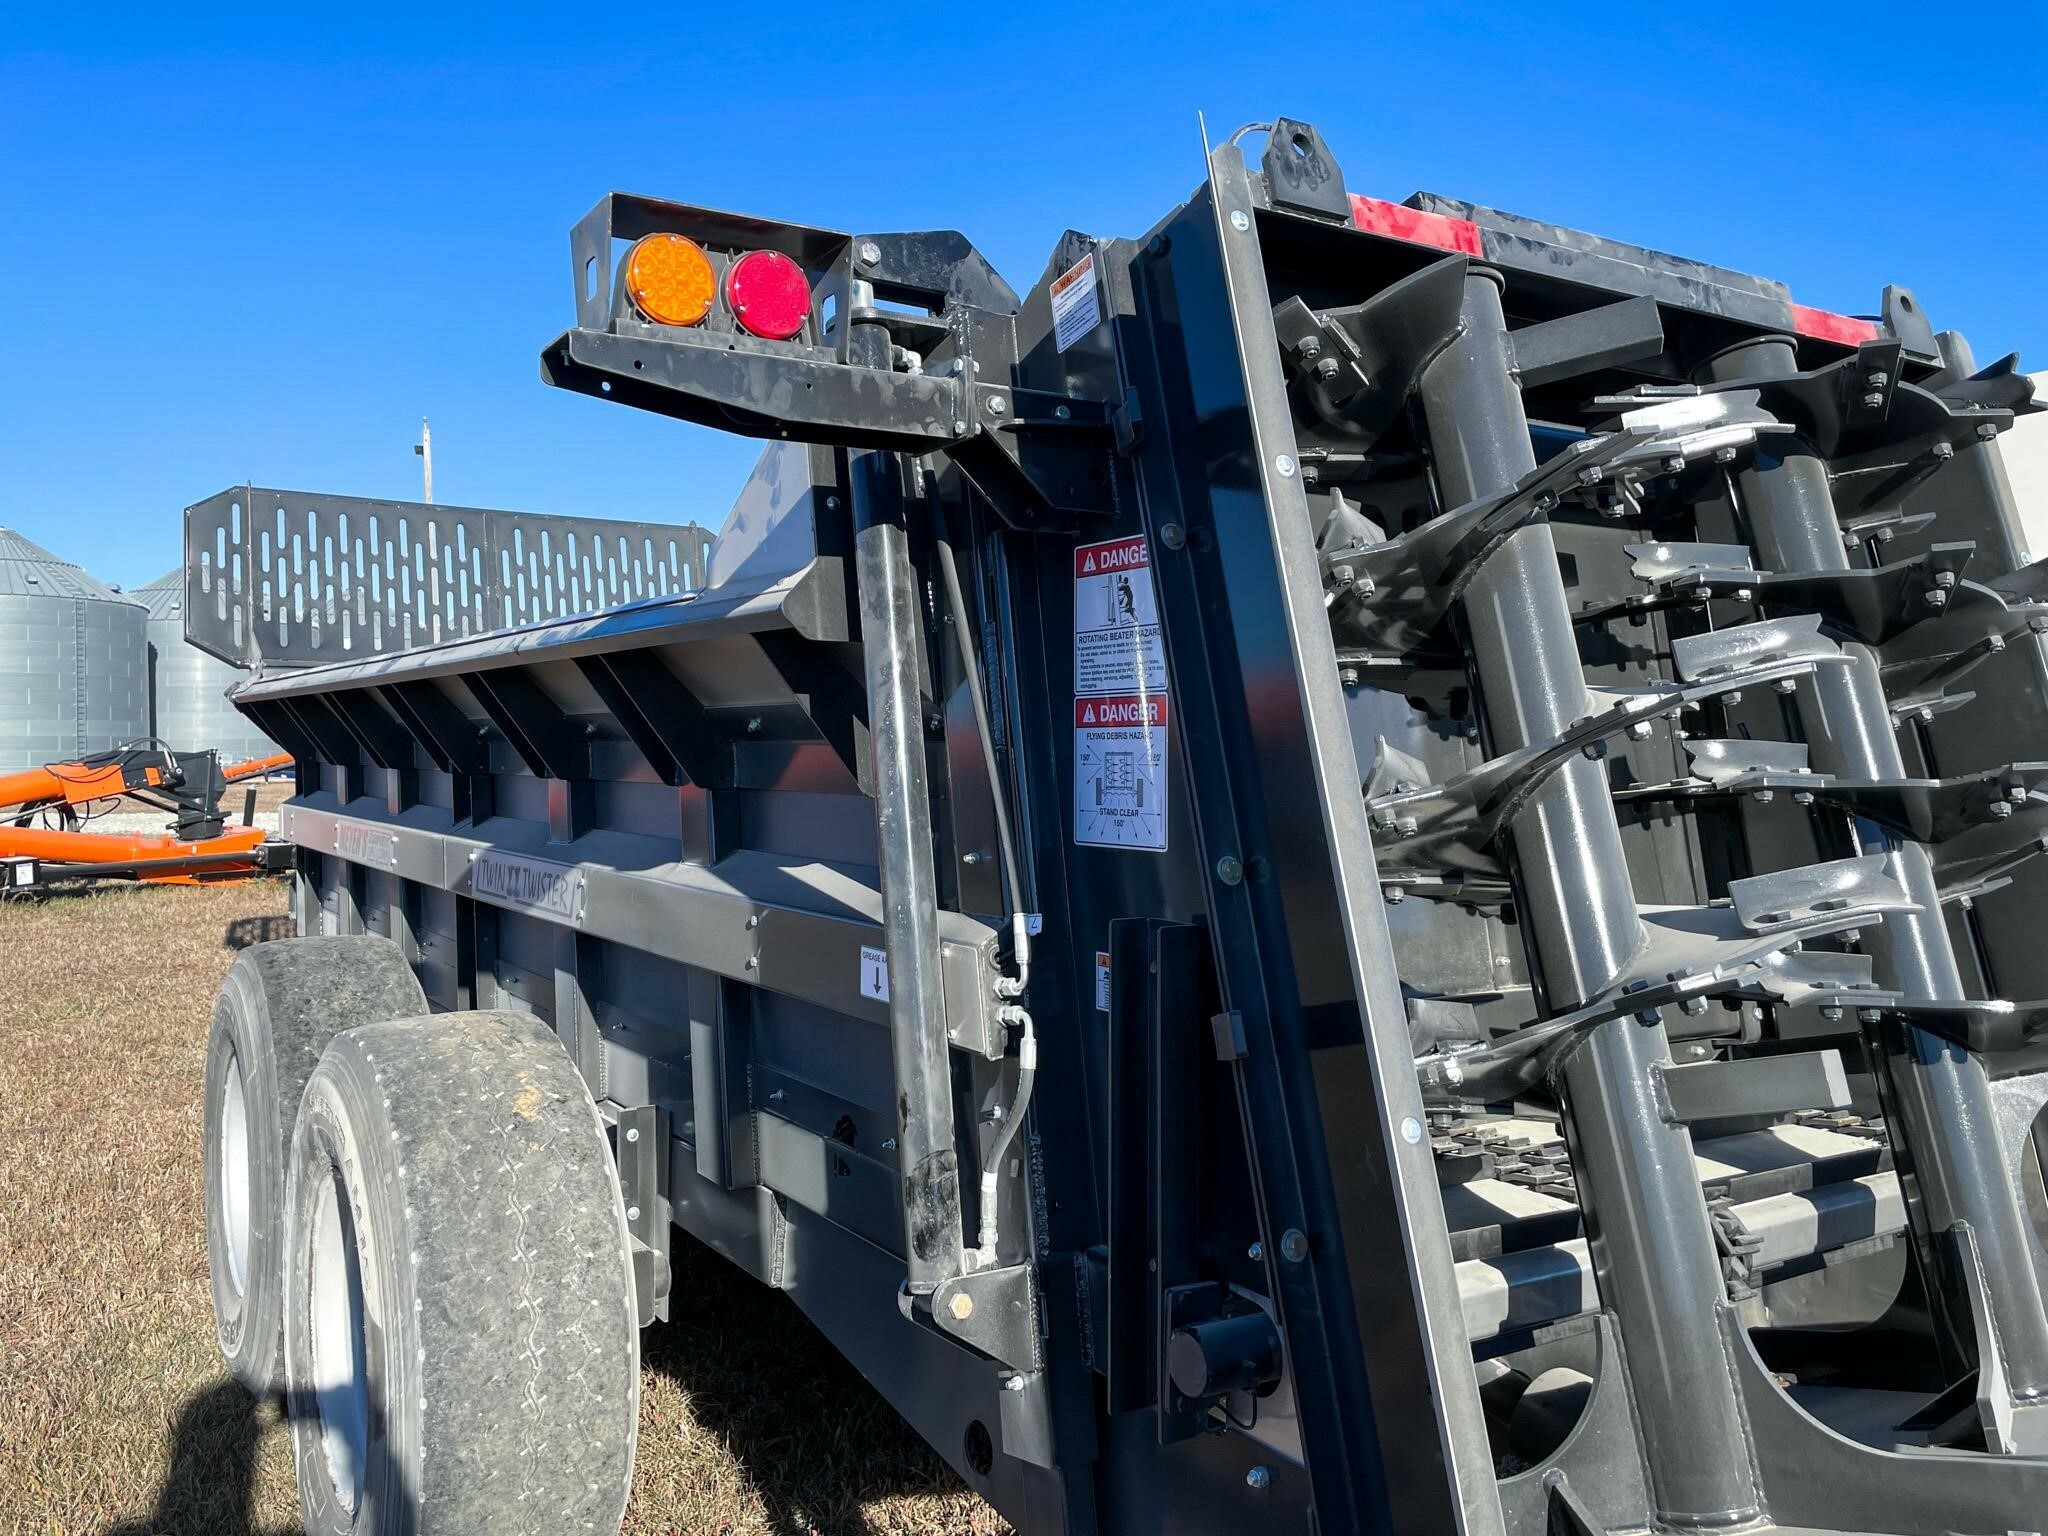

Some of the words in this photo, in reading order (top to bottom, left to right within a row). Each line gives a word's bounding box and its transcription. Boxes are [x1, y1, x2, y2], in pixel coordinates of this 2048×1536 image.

[1100, 544, 1149, 569] DANGE
[1078, 633, 1109, 644] ROTATING
[1109, 630, 1134, 641] BEATER
[1136, 627, 1161, 638] AZARD
[1100, 702, 1158, 722] DANGER
[1086, 732, 1106, 740] FLYING
[1107, 731, 1128, 740] DEBRIS
[1129, 731, 1154, 740] HAZAD
[1100, 807, 1119, 816] STAND
[1120, 808, 1139, 817] CLEAR
[482, 858, 506, 892] TWIN
[523, 867, 569, 912] TWISTER
[862, 951, 881, 963] GREASE
